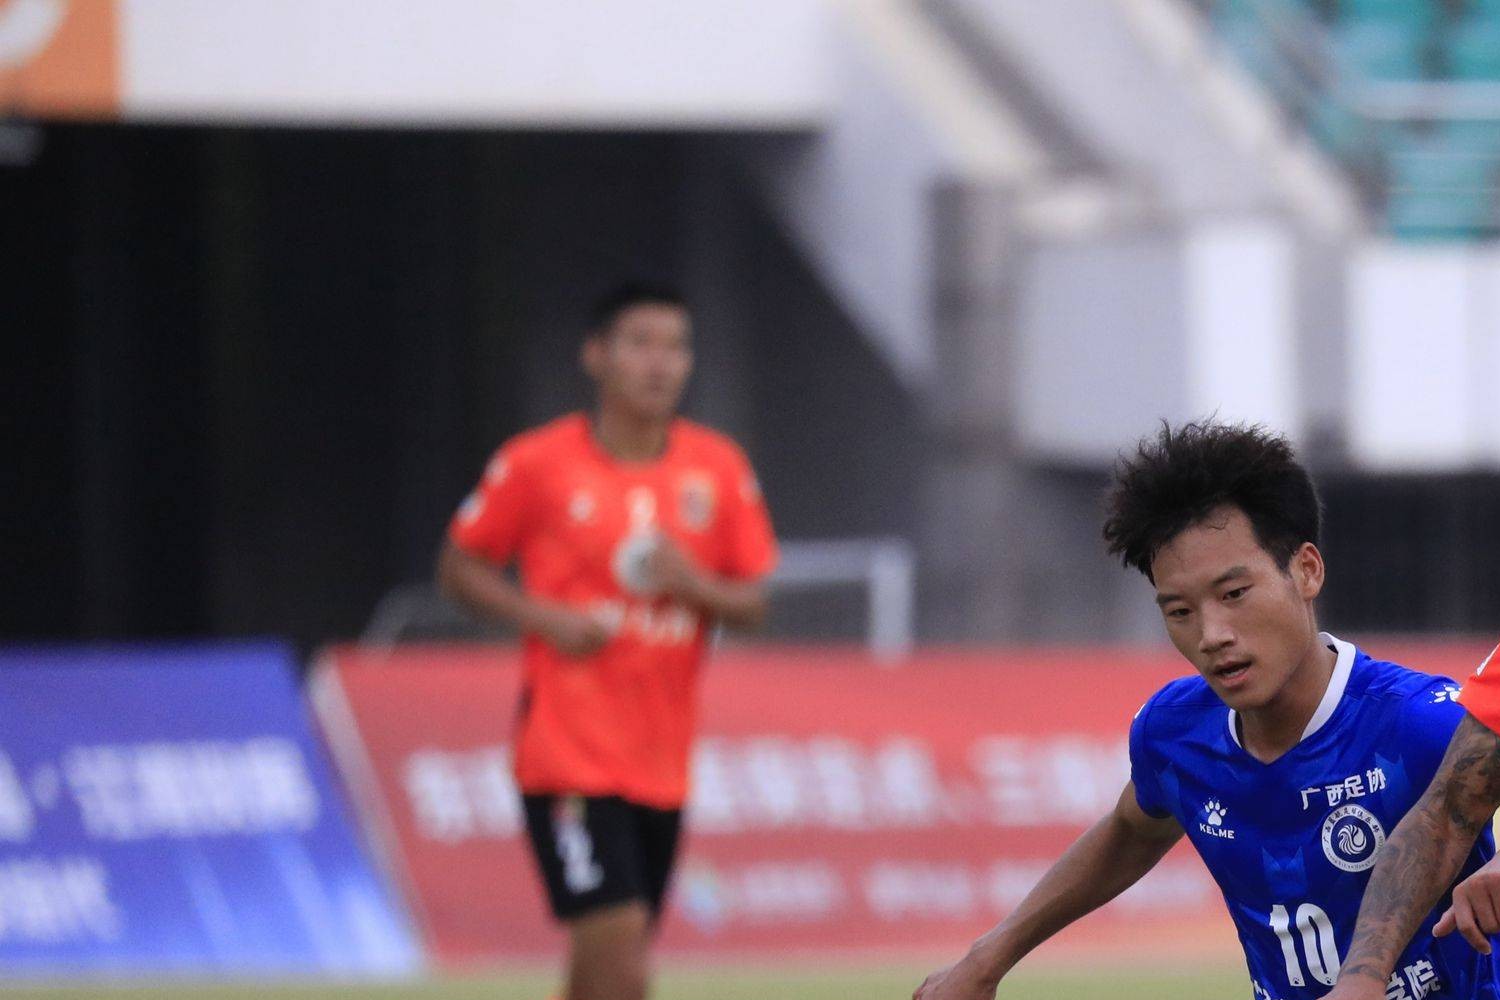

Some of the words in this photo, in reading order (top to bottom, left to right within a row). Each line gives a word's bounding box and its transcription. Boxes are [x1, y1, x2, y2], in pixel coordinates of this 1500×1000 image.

[1301, 767, 1387, 811] 广西足协
[1199, 822, 1236, 840] KELME
[1269, 902, 1342, 988] 10
